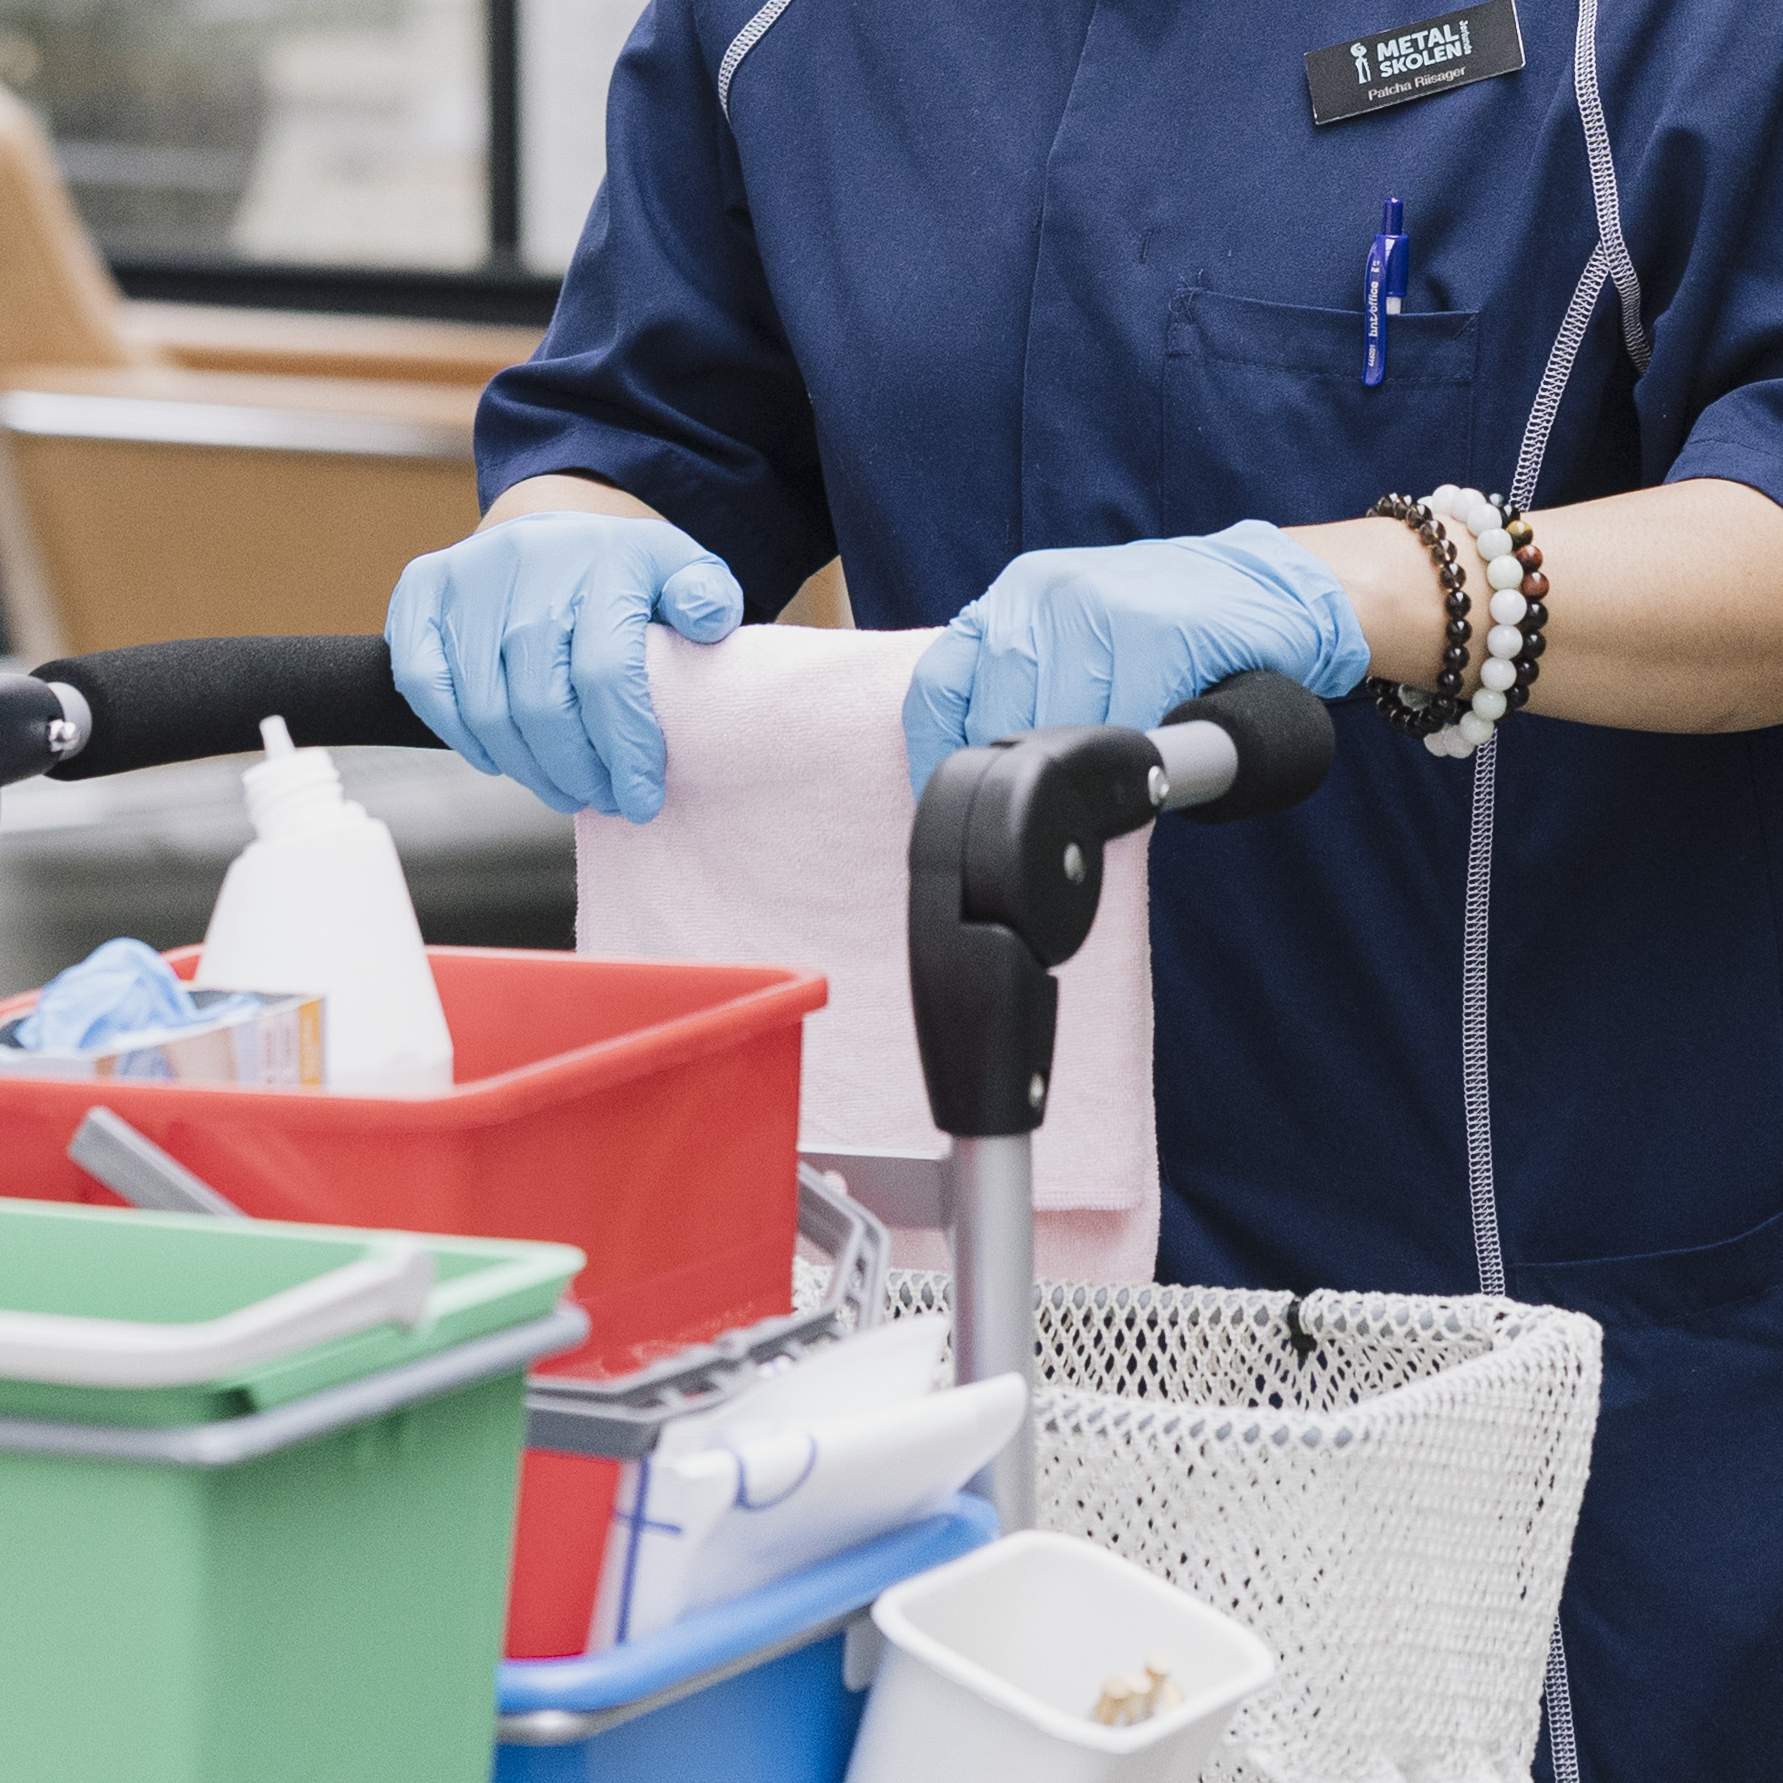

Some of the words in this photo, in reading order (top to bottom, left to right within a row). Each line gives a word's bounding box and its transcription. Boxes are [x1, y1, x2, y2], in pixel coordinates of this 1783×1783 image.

[1377, 24, 1459, 61] METAL
[1379, 41, 1463, 78] SKOLEN
[1368, 81, 1412, 101] Patcha
[1414, 66, 1467, 88] Riisager
